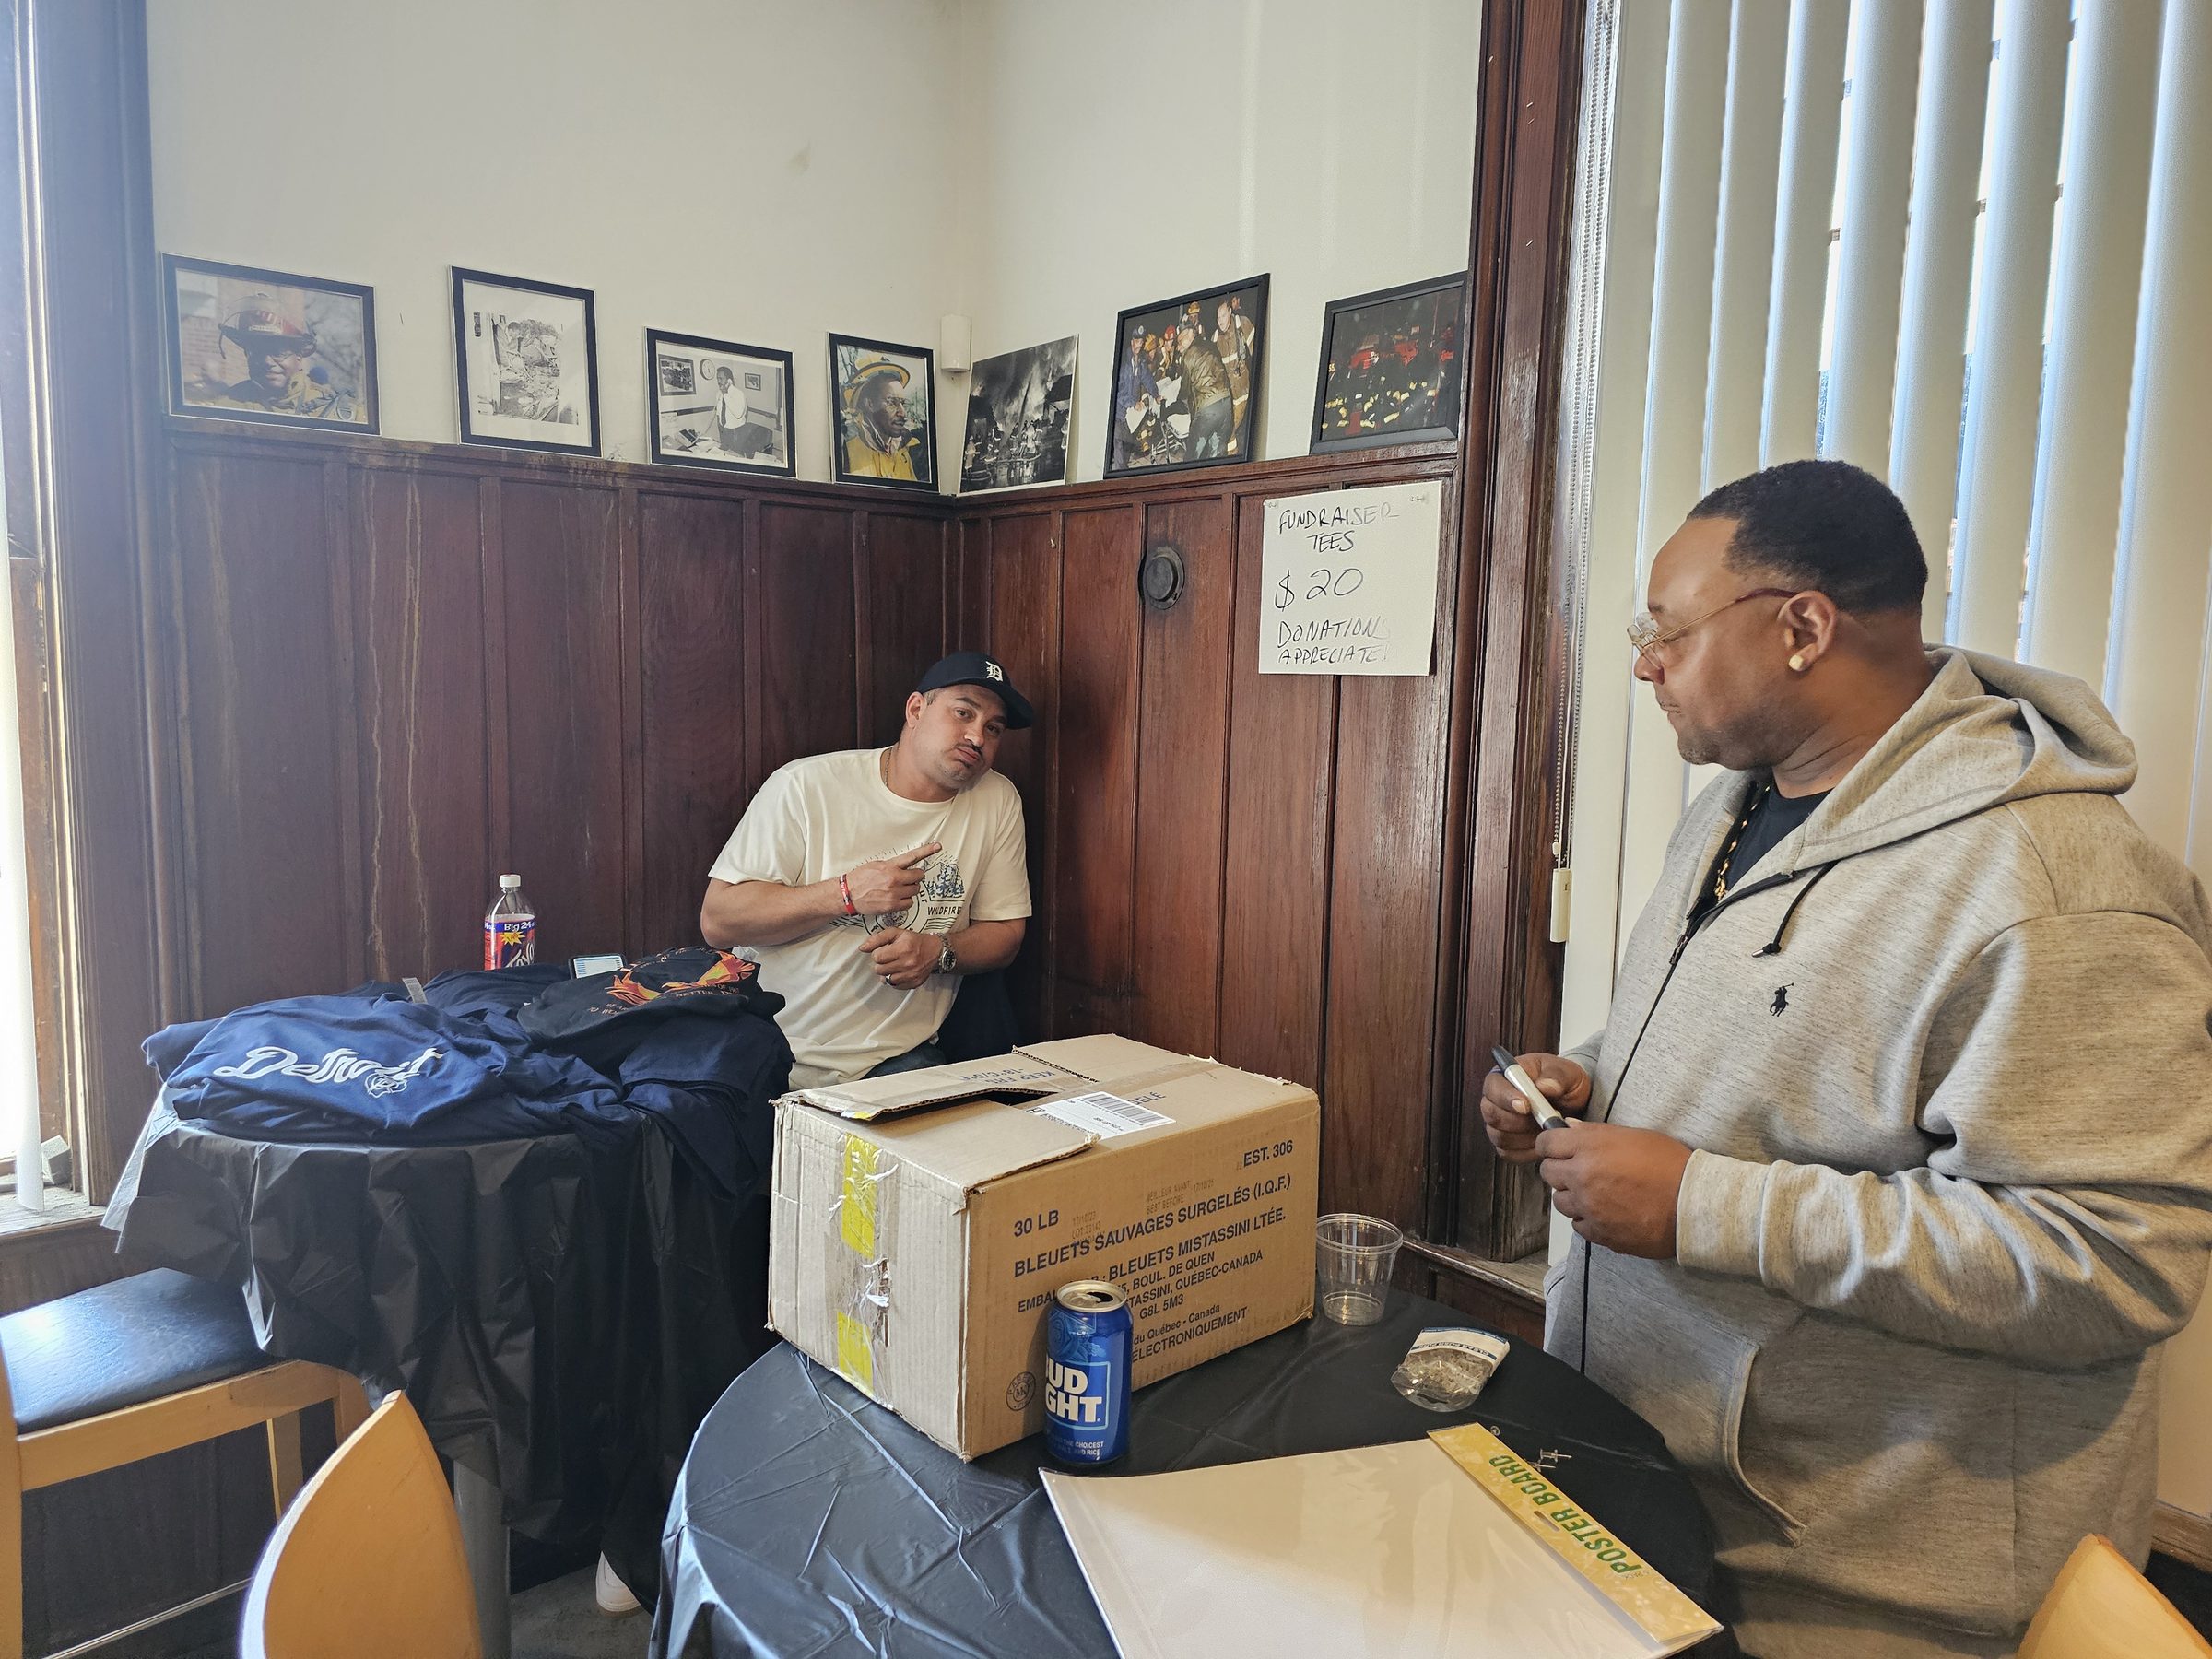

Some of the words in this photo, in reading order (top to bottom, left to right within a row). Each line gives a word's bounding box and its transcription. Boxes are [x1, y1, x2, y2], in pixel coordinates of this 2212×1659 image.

[1278, 502, 1400, 534] FUNDRAISER
[1306, 530, 1355, 553] TEES
[984, 661, 1004, 682] D
[504, 924, 520, 932] Big
[213, 1046, 443, 1083] Detroit
[1243, 1147, 1270, 1168] EST.
[1273, 1140, 1293, 1159] 306
[1014, 1218, 1032, 1238] 30
[1038, 1209, 1059, 1230] LB
[1015, 1240, 1090, 1277] BLEUETS
[1094, 1212, 1174, 1251] SAUVAGES
[1178, 1186, 1250, 1224] SURGELÉS
[1253, 1172, 1291, 1200] (I.Q.F.)
[1109, 1246, 1173, 1282] BLEUETS
[1178, 1218, 1250, 1257] MISTASSINI
[1253, 1206, 1286, 1231] LTÉE.
[1133, 1271, 1166, 1291] BOUL.
[1169, 1263, 1182, 1277] DE
[1185, 1251, 1215, 1271] QUEN
[1175, 1249, 1263, 1291] QUÉBEC-CANADA
[1018, 1290, 1058, 1313] EMBAL
[1139, 1304, 1159, 1321] G8L
[1163, 1293, 1184, 1312] 5M3
[1133, 1306, 1248, 1363] ÉLECTRONIQUEMENT
[1134, 1333, 1145, 1346] du
[1147, 1319, 1182, 1341] Québec
[1188, 1304, 1220, 1324] Canada
[1045, 1354, 1088, 1394] UD
[1045, 1382, 1103, 1423] GHT
[1075, 1441, 1104, 1449] CHOICEST
[1489, 1454, 1562, 1506] BOARD
[1549, 1507, 1643, 1574] POSTER
